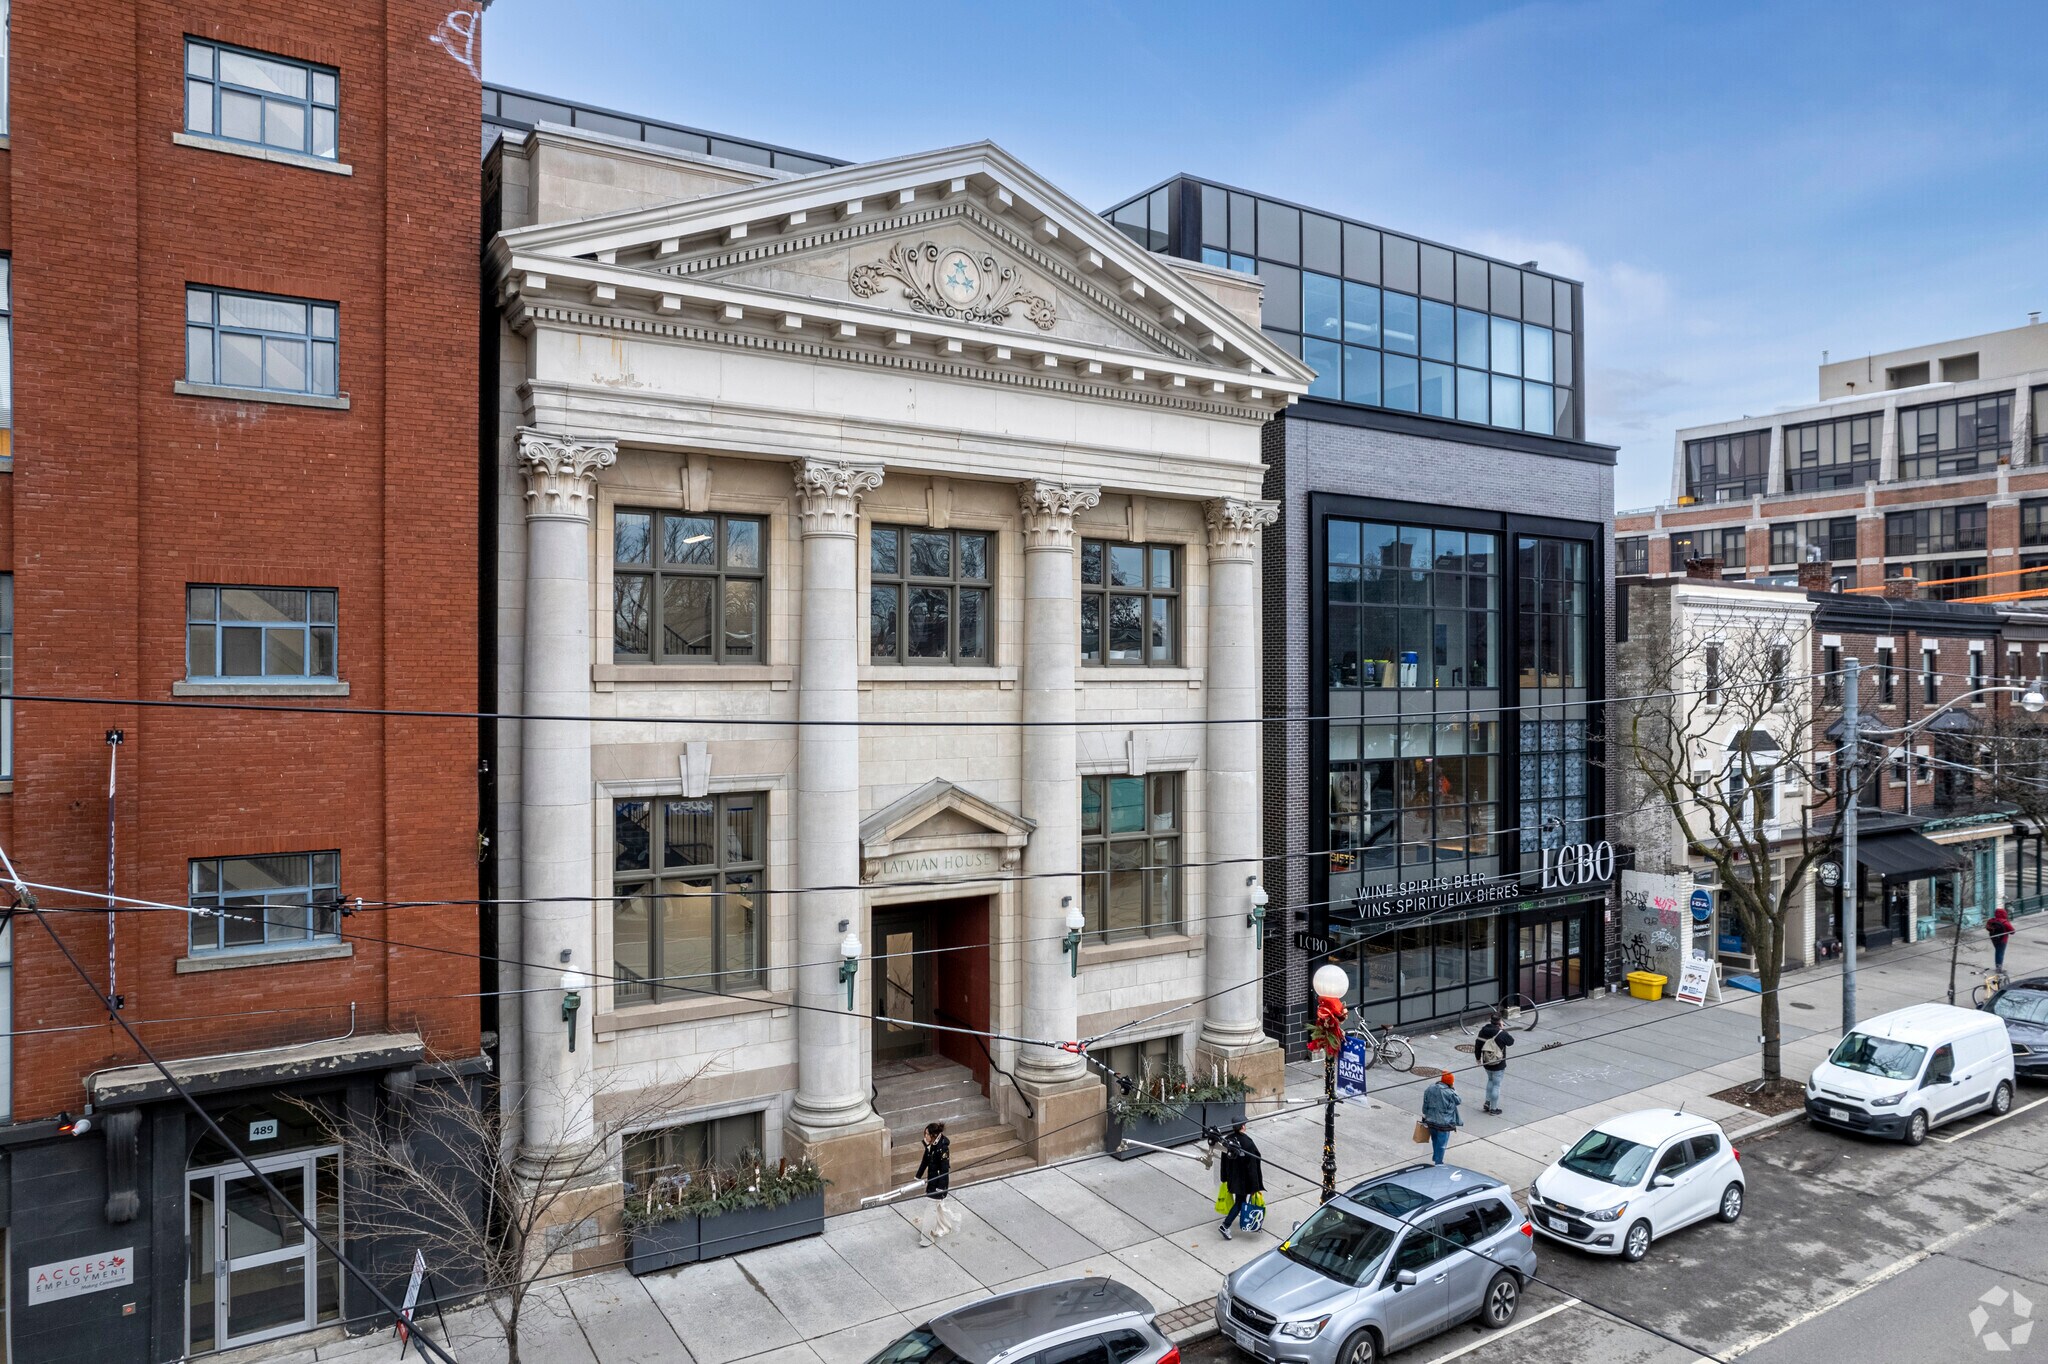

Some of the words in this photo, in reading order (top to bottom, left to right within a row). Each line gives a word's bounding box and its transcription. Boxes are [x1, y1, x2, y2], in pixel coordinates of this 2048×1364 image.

[883, 858, 938, 874] LATVIAN
[944, 853, 991, 869] HOUSE
[1541, 840, 1614, 889] LCBO
[1454, 872, 1486, 889] BEER
[1358, 901, 1391, 918] VINS
[1299, 934, 1328, 953] LCBO
[1339, 1060, 1364, 1074] BUON
[1339, 1069, 1364, 1082] NATALE
[252, 1125, 274, 1136] 489
[36, 1267, 126, 1293] EMPLOYMENT
[37, 1260, 106, 1284] ACCES
